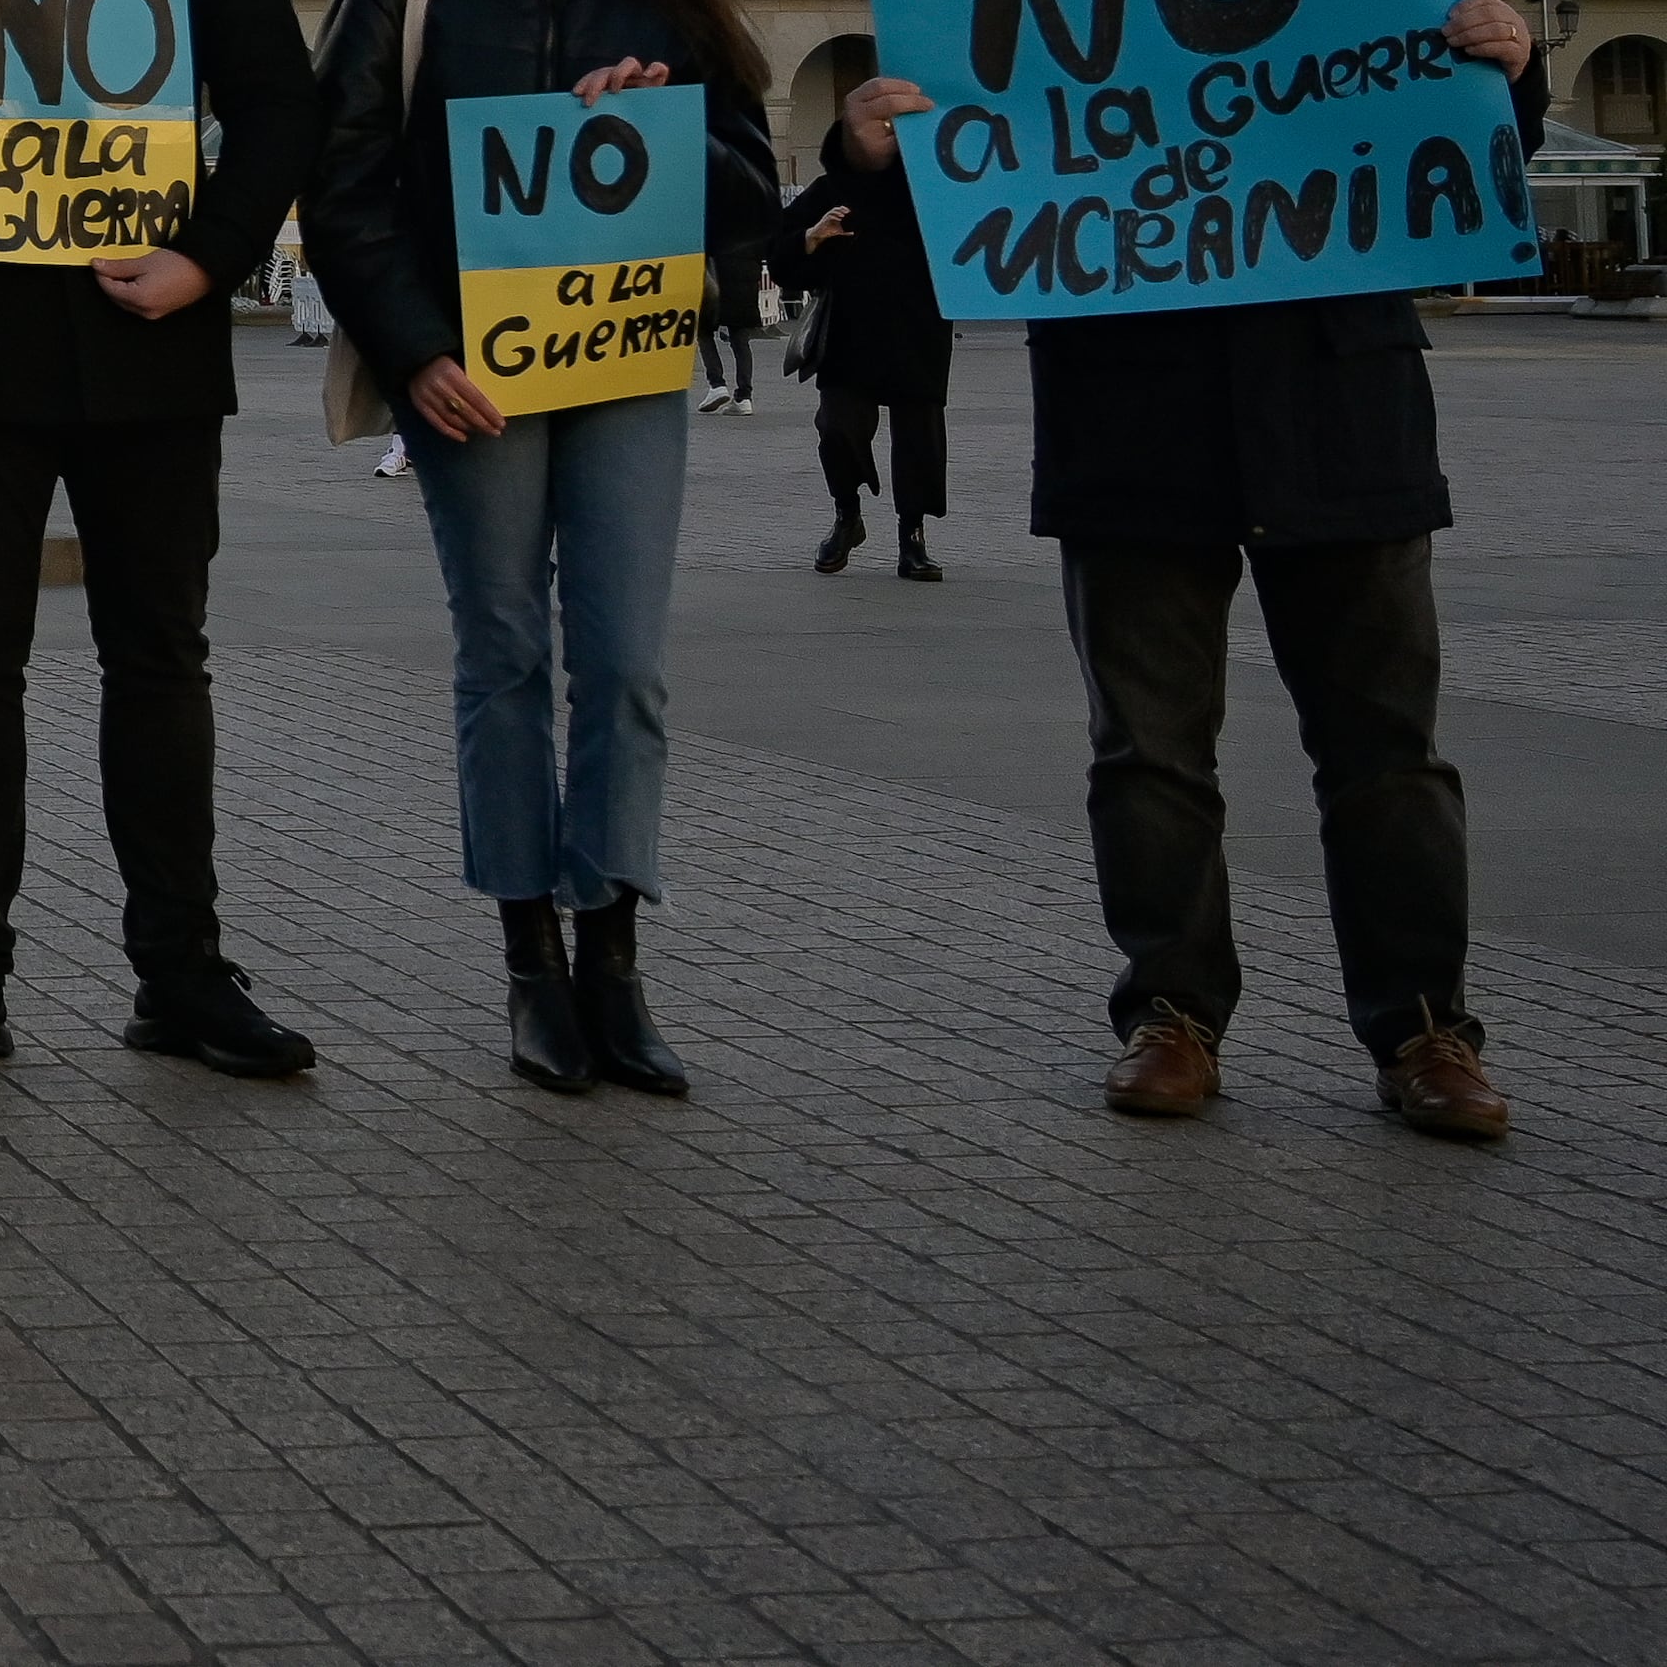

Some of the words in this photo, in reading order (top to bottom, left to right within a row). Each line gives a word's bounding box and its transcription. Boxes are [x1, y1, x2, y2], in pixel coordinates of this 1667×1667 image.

[934, 105, 1019, 182] a
[1188, 28, 1473, 137] Guerr
[2, 121, 59, 176] a
[482, 114, 649, 216] NO
[1131, 140, 1232, 211] de
[557, 270, 594, 306] a
